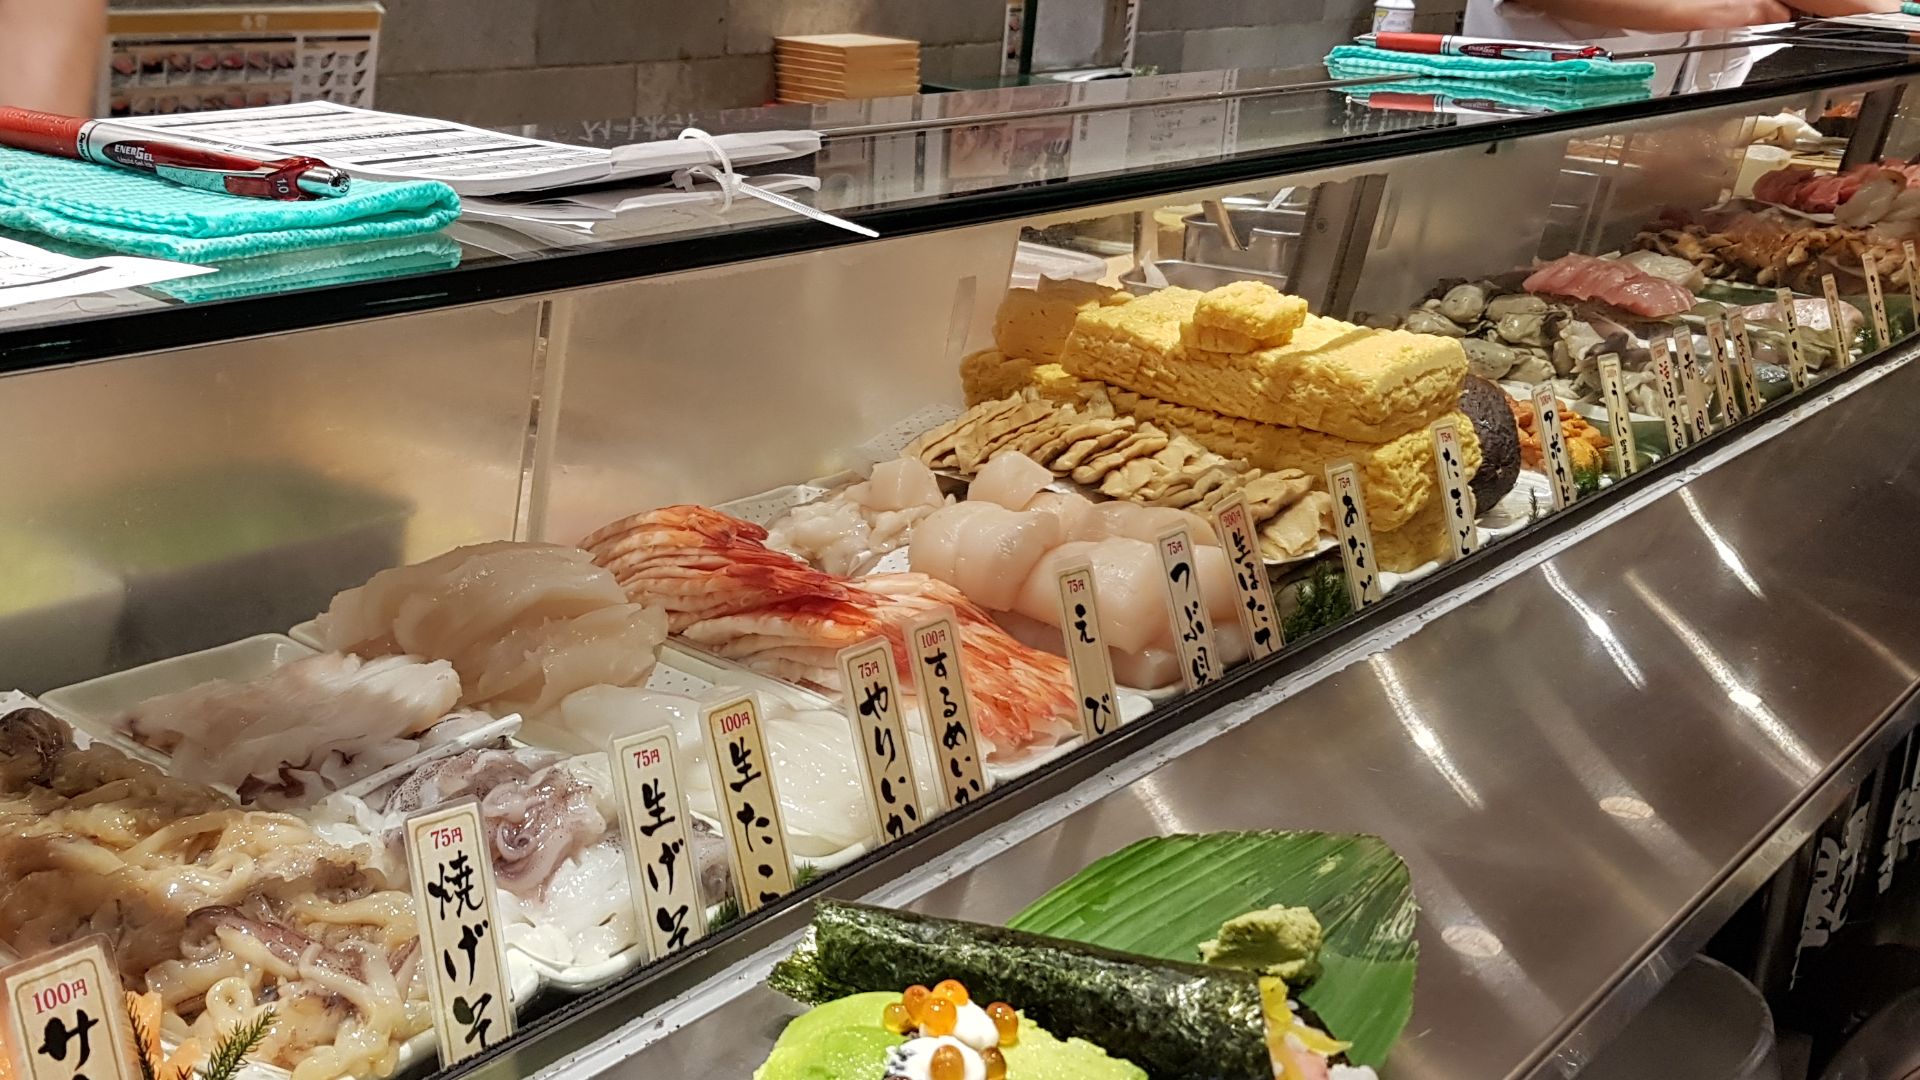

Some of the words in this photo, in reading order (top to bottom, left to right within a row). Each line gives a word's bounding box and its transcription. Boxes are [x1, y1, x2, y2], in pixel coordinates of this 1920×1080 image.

[1166, 541, 1184, 556] 75円
[1342, 490, 1373, 606] あなご
[1442, 447, 1472, 556] たまご
[920, 629, 947, 649] 100円
[1066, 579, 1085, 595] 75円
[1169, 562, 1214, 687] つぶ貝
[1231, 527, 1274, 652] 生ほたて
[718, 711, 752, 735] 100円
[856, 660, 881, 680] 75円
[632, 748, 661, 769] 75円
[859, 681, 917, 840] やりいか
[924, 648, 980, 806] するめいか
[429, 826, 464, 851] 75円
[639, 777, 690, 950] 生げそ
[729, 736, 781, 907] 生たこ
[32, 978, 89, 1015] 100円
[427, 852, 494, 1049] 焼げそ
